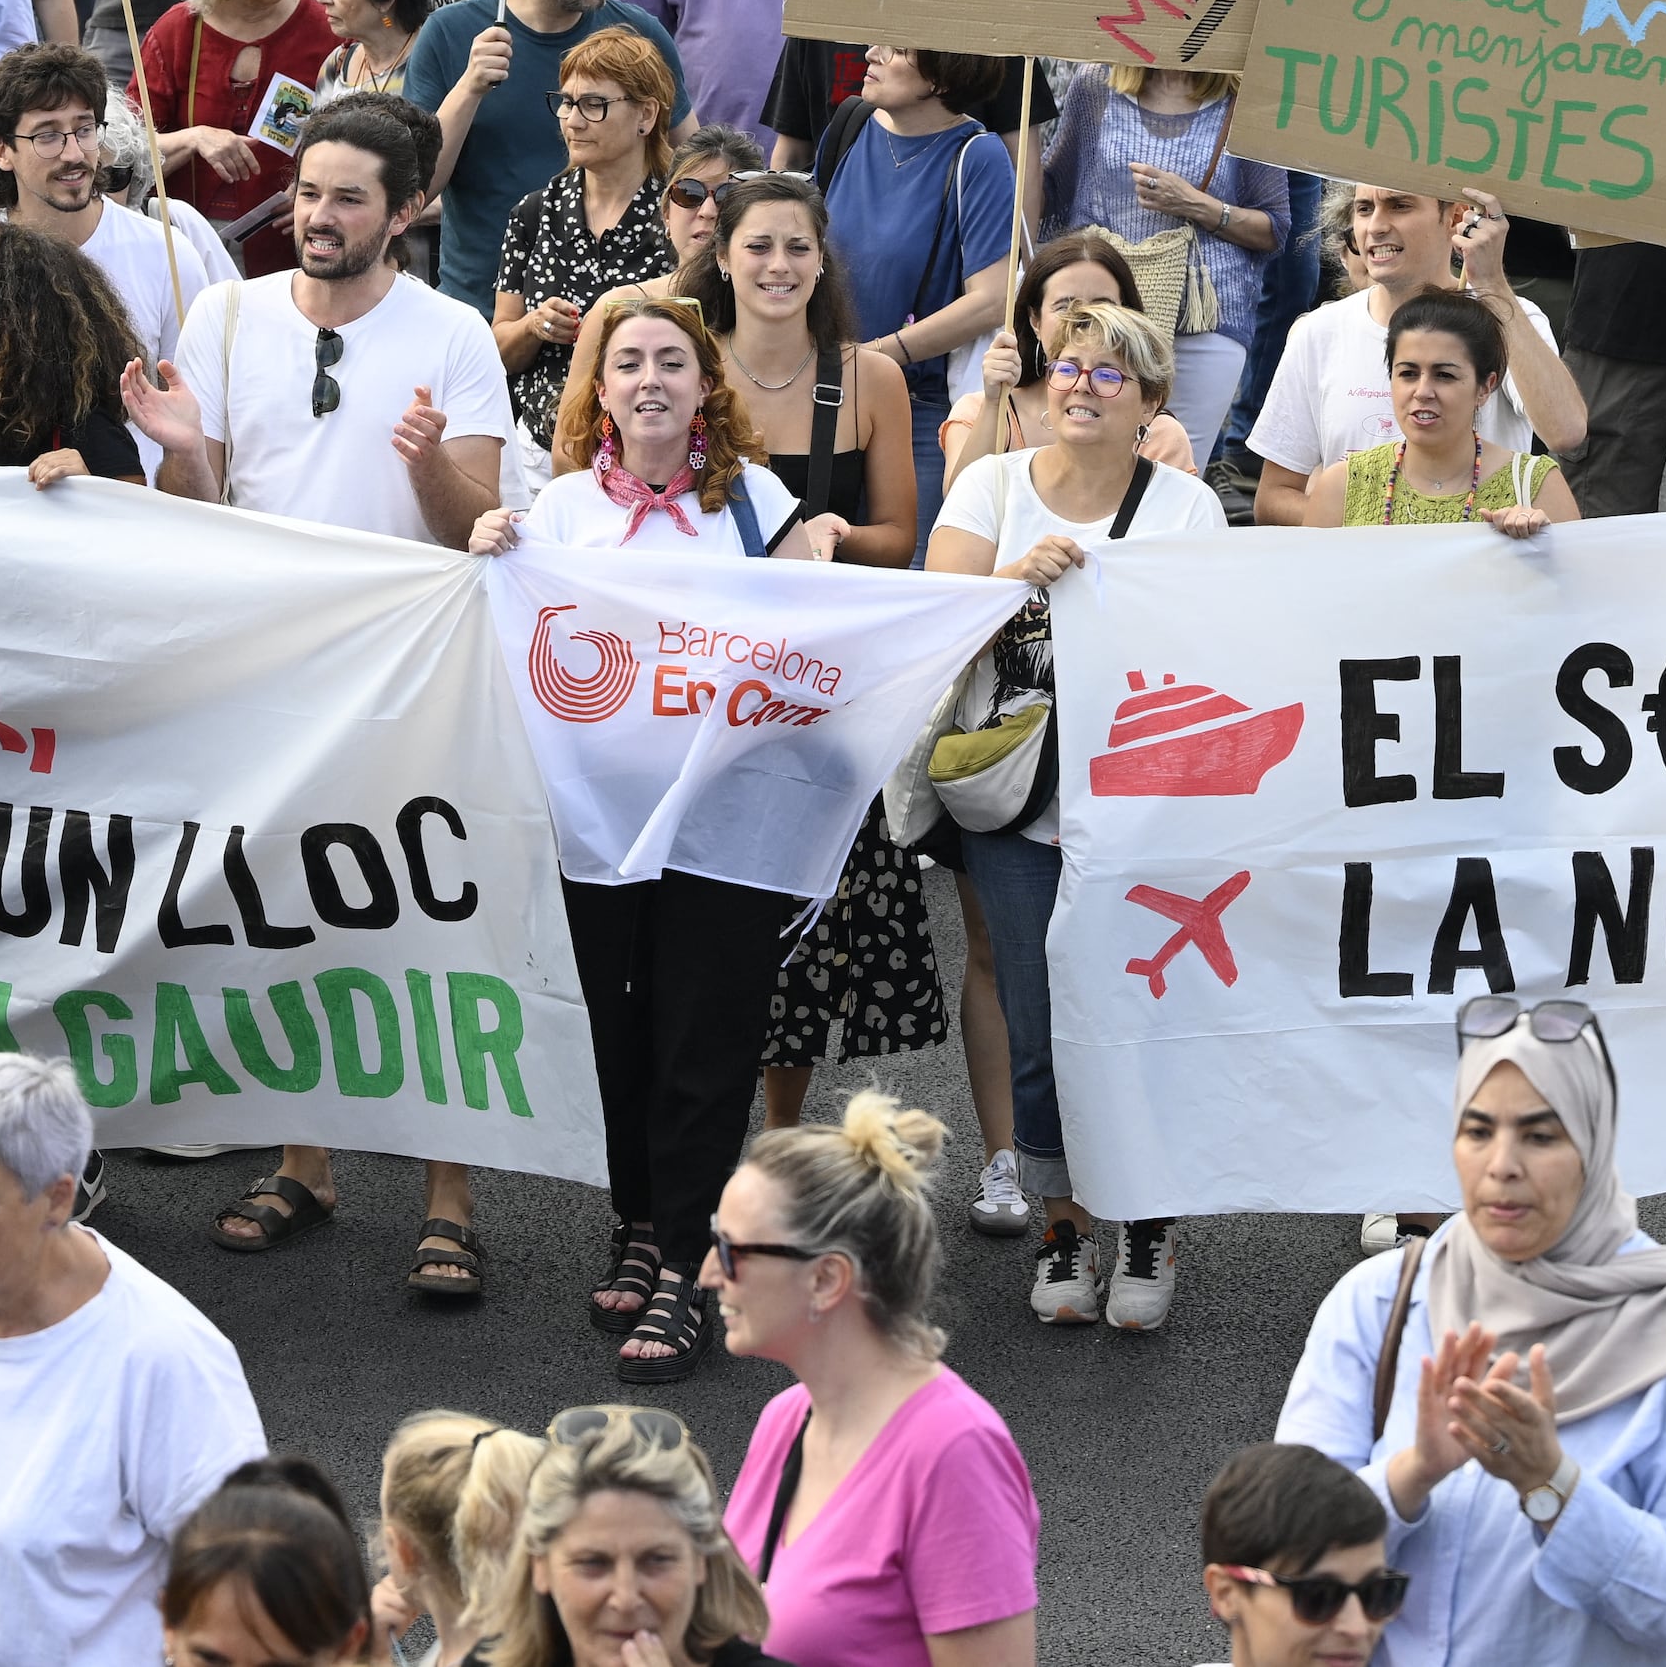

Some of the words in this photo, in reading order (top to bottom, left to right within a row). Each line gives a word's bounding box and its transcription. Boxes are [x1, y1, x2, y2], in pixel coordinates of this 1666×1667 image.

[652, 664, 717, 717] En
[657, 620, 843, 697] Barcelona
[1338, 654, 1505, 808] EL
[156, 794, 479, 952] LLOC
[1338, 855, 1517, 999] LA
[51, 965, 535, 1119] GAUDIR
